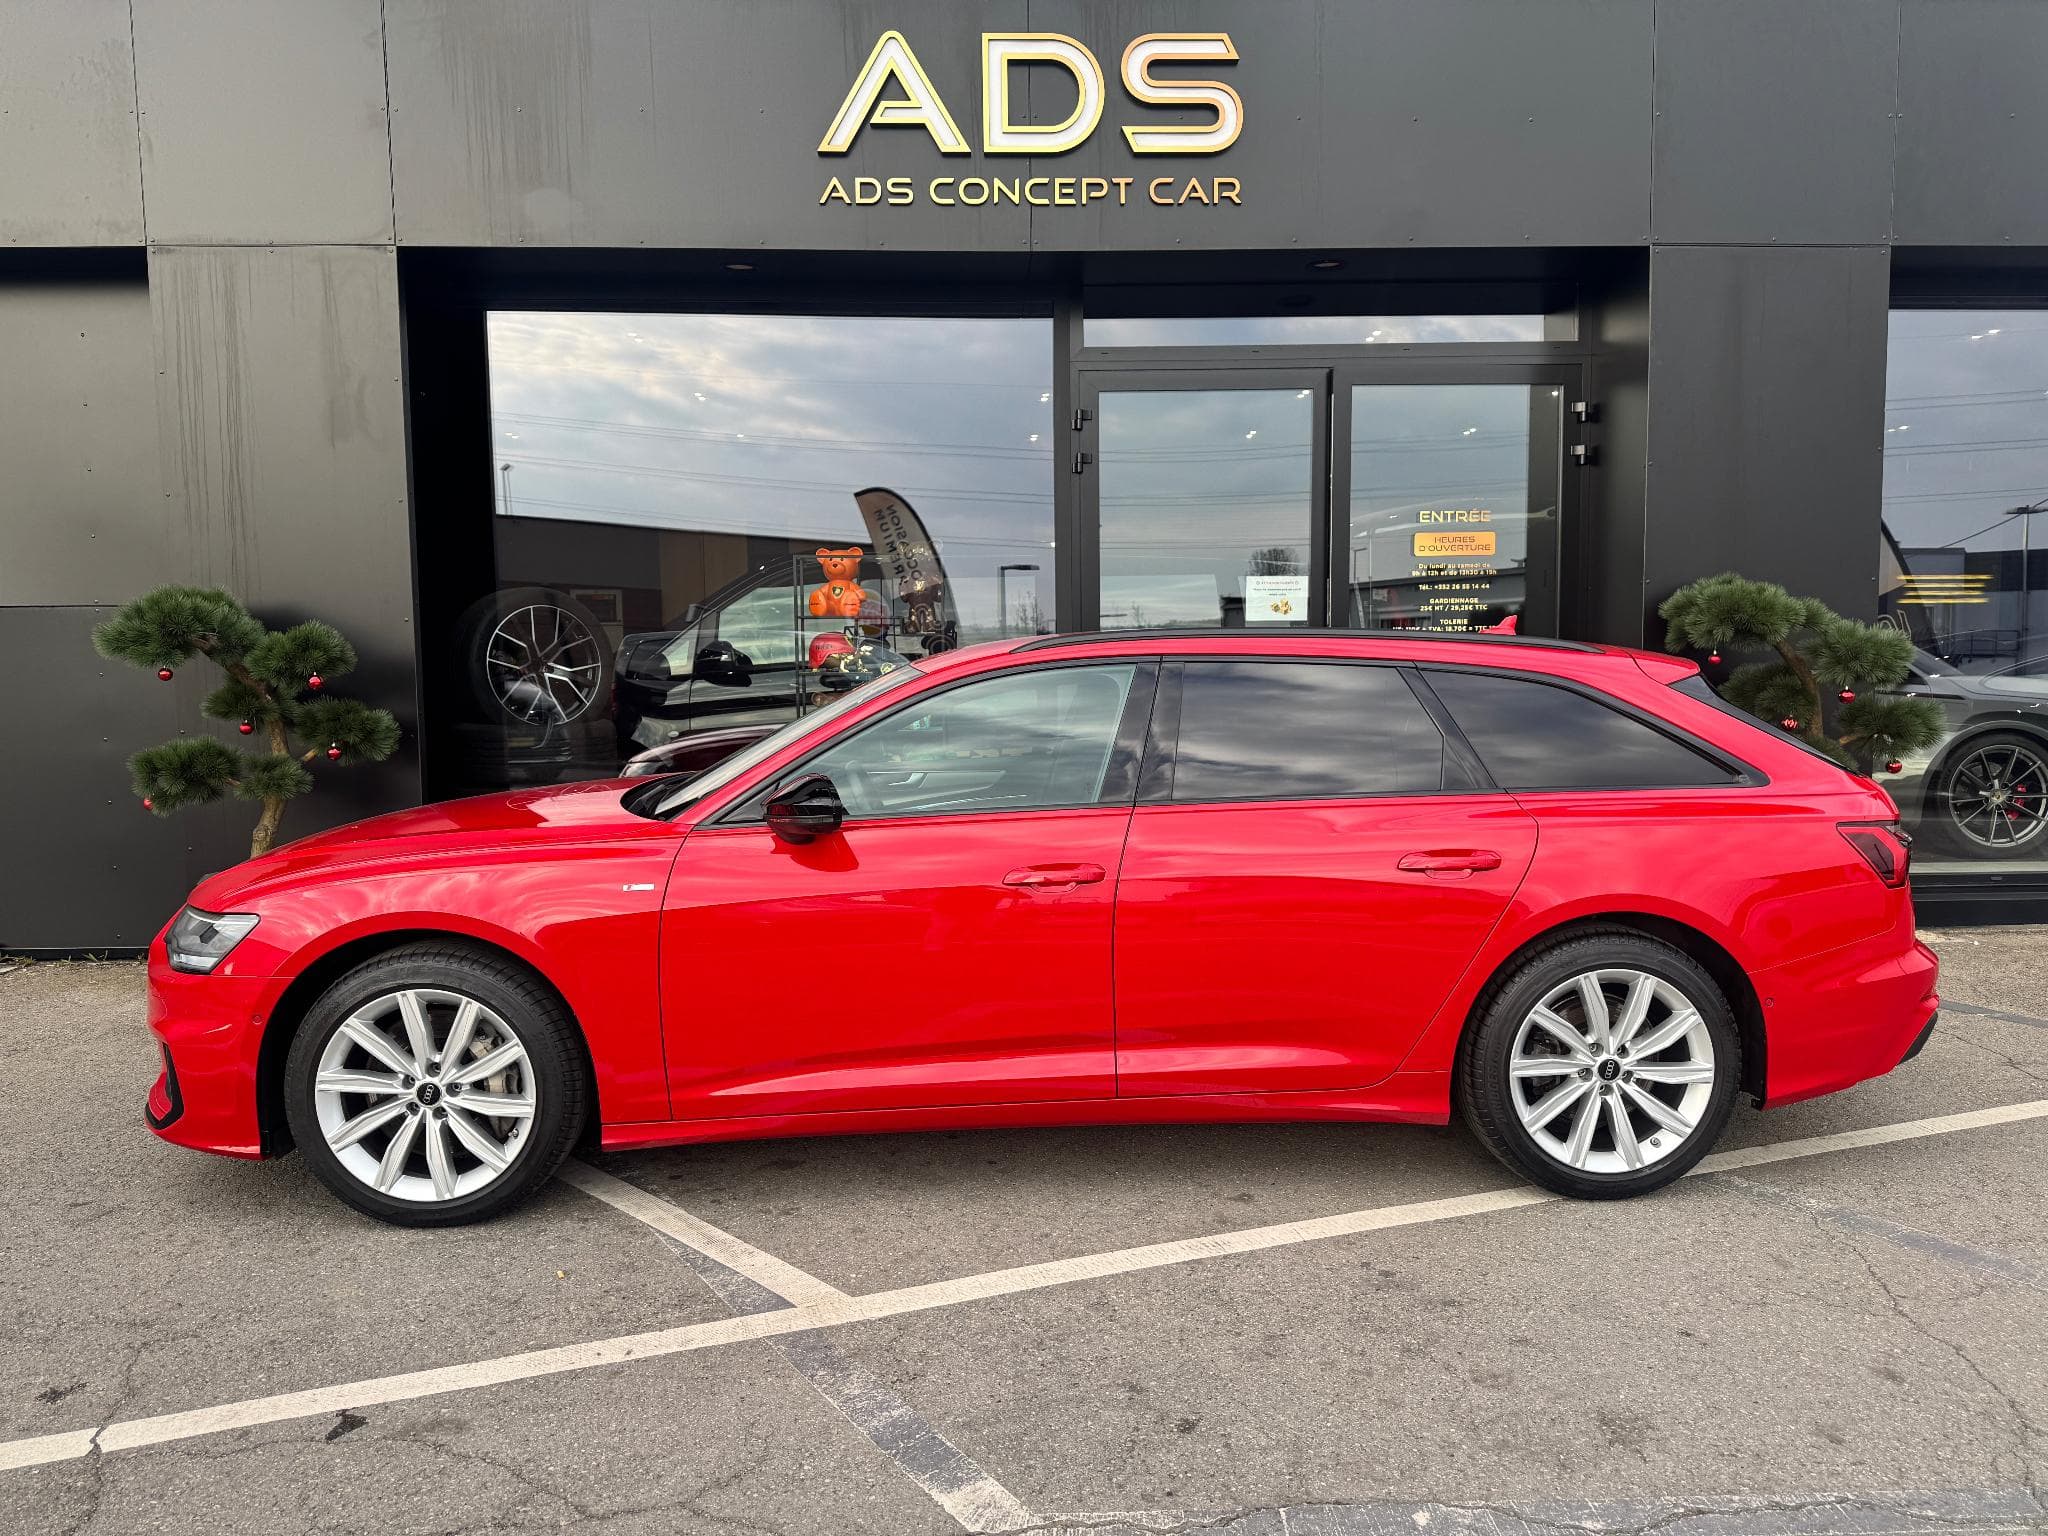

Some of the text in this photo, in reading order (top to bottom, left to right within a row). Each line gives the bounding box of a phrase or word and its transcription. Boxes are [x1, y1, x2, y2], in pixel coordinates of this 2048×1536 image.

[817, 30, 1244, 154] ADS
[819, 176, 1242, 204] ADS CONCEPT CAR
[1419, 508, 1492, 523] ENTRÉE
[1434, 536, 1475, 544] HEURES
[1418, 544, 1491, 552] D'OUVERTURE
